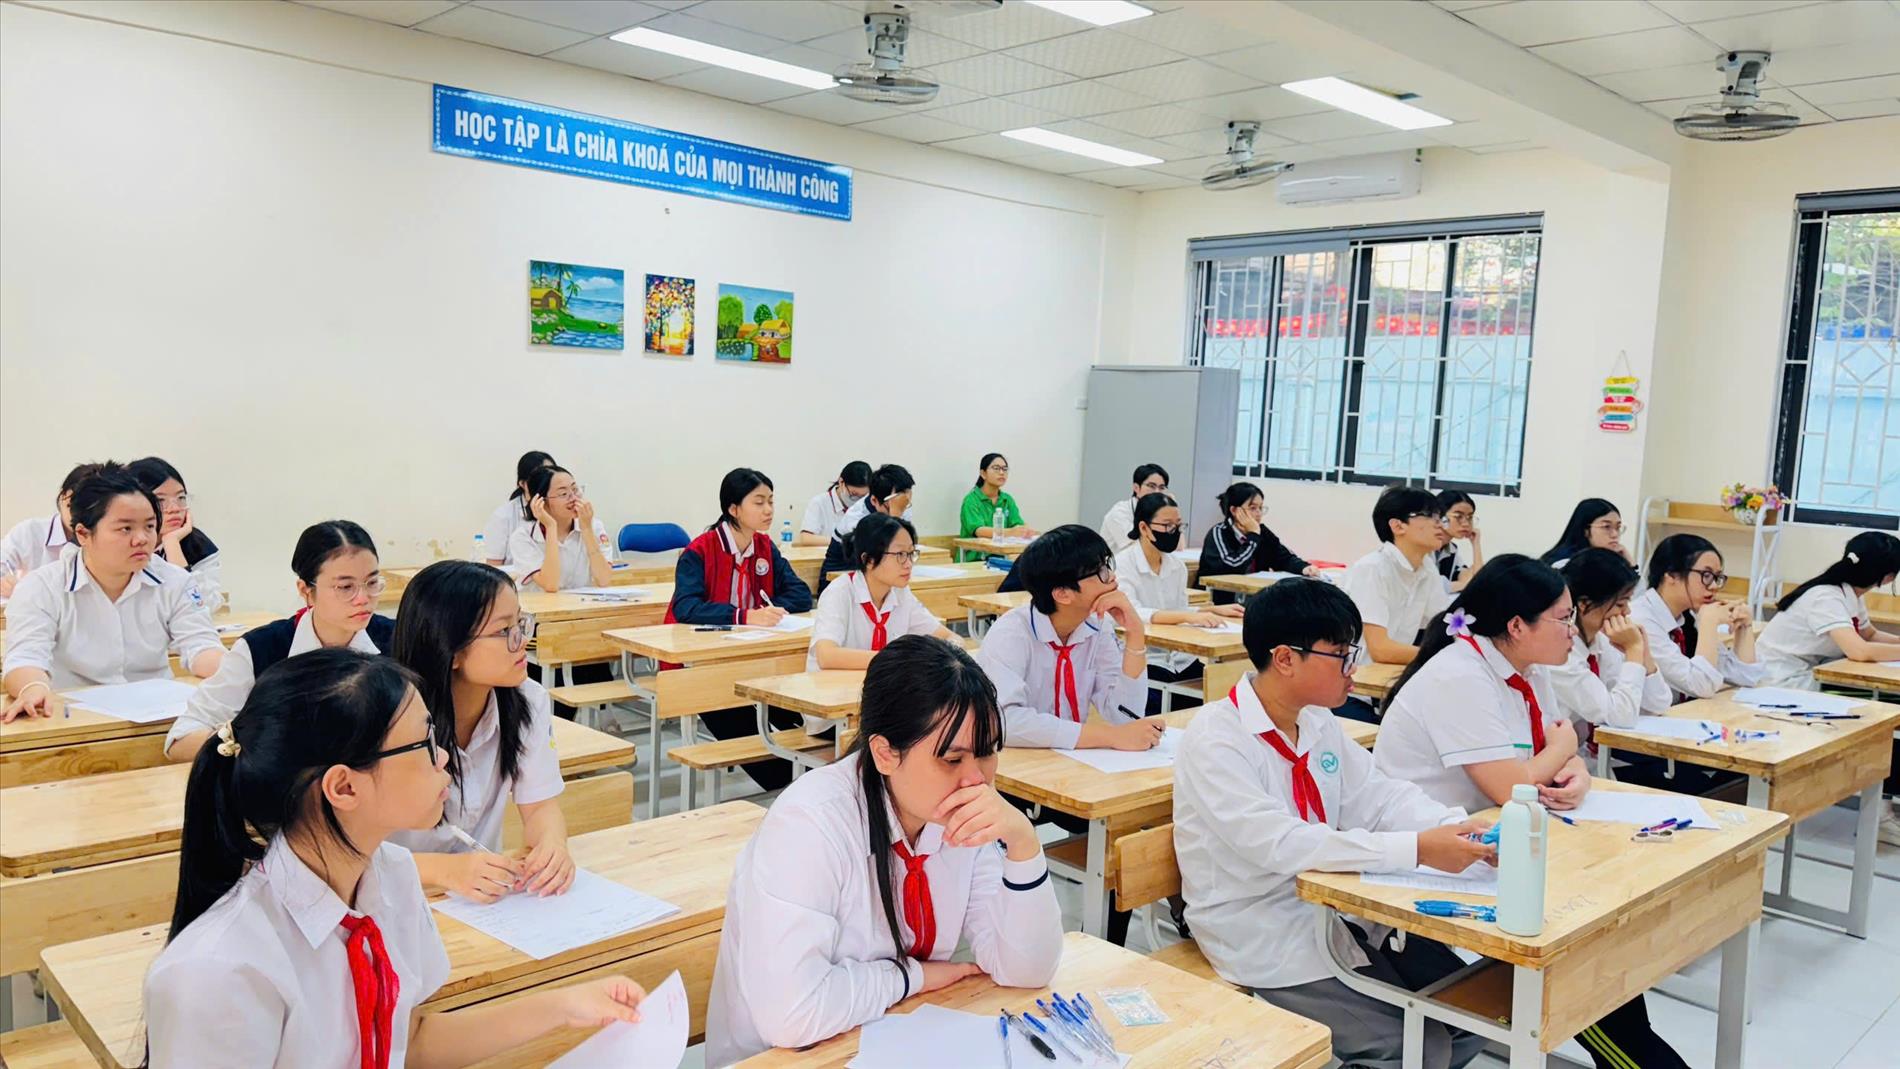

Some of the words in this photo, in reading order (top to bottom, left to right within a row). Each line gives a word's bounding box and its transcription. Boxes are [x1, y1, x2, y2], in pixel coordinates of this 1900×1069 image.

[454, 109, 497, 145] HỌC
[502, 115, 540, 153] TẬP
[545, 122, 570, 155] LÀ
[574, 130, 619, 164] CHÌA
[622, 141, 670, 173] KHOÁ
[674, 145, 708, 180] CỦA
[712, 158, 743, 190] MỌI
[747, 163, 797, 196] THÀNH
[800, 172, 839, 204] CÔNG
